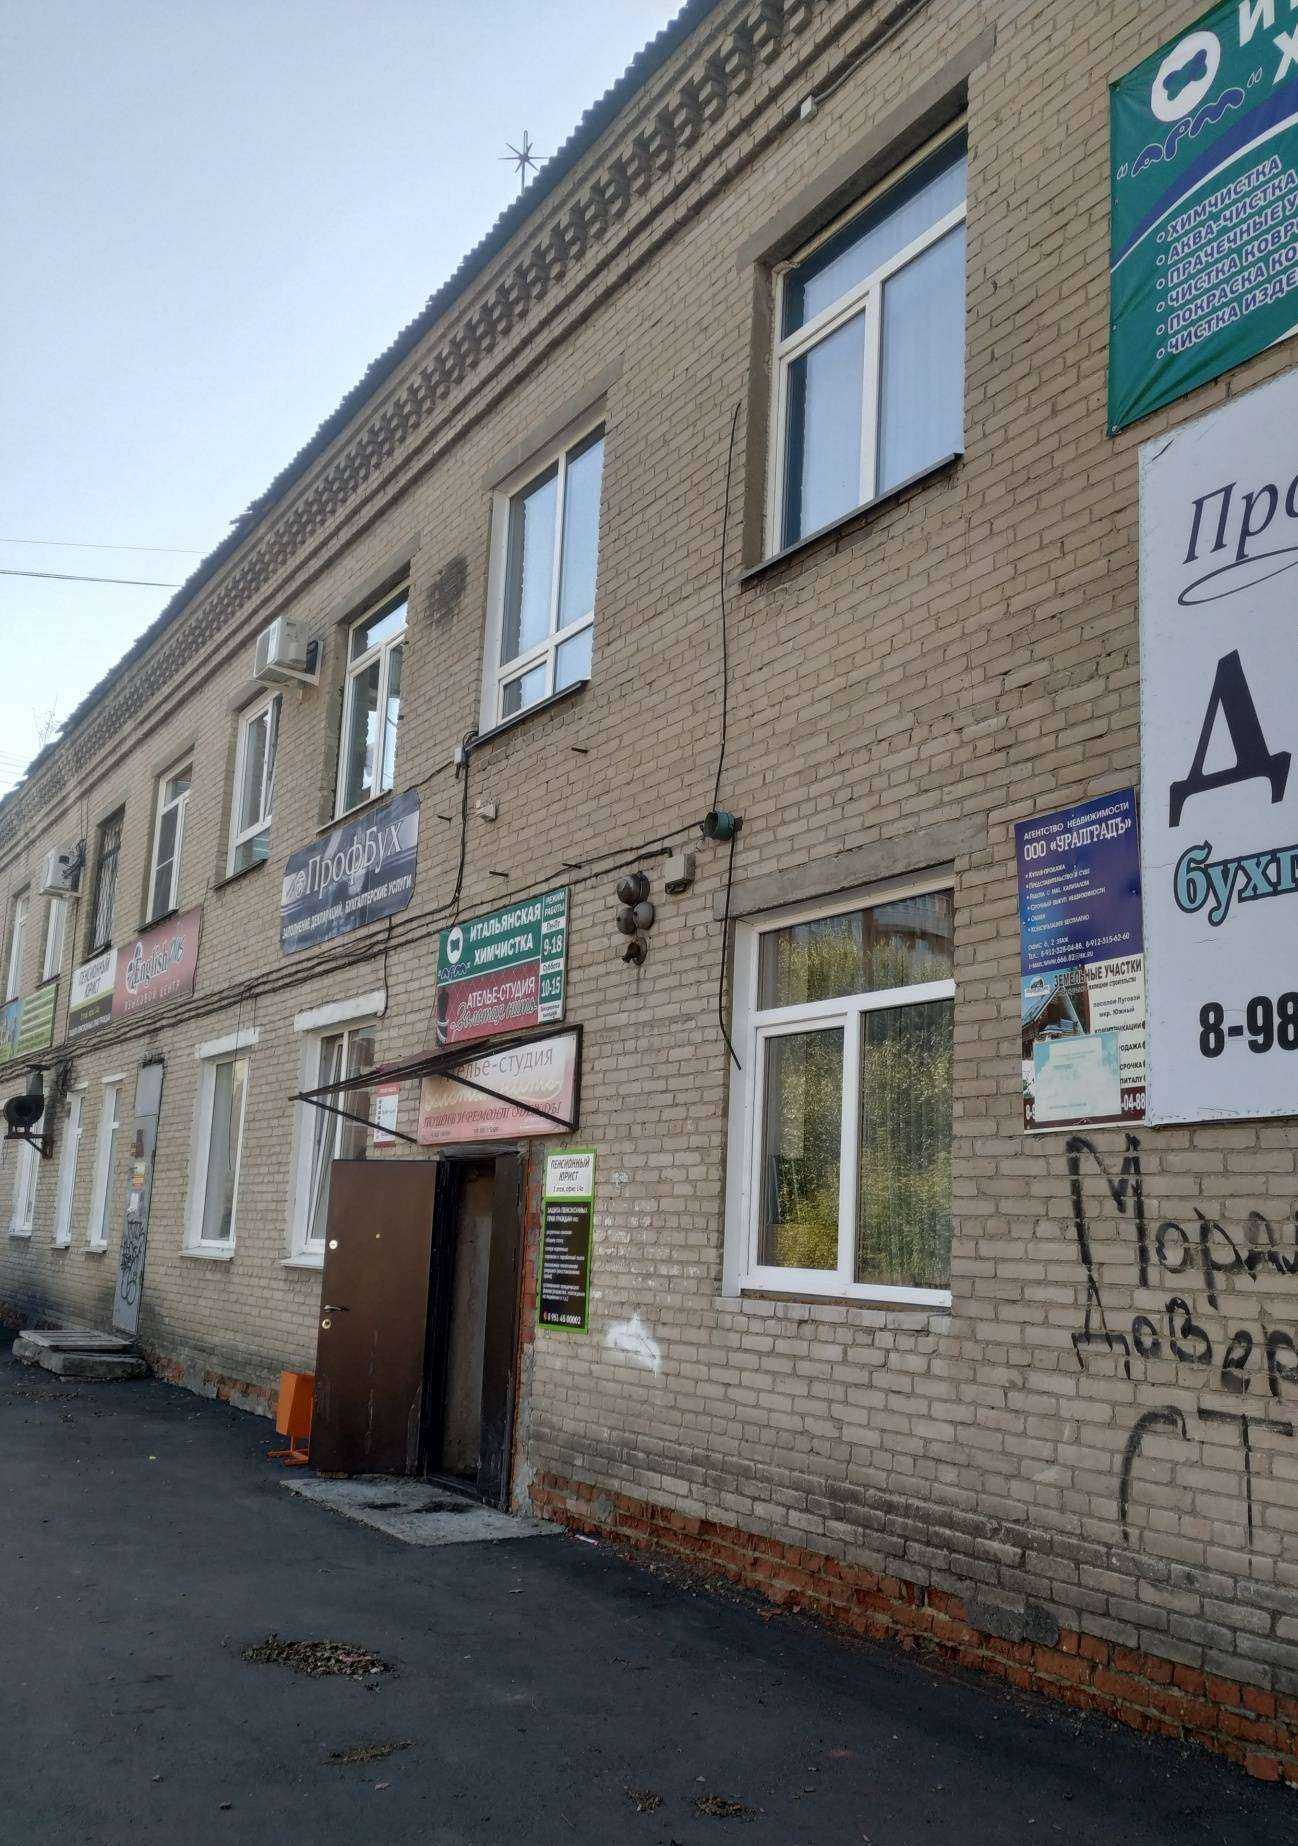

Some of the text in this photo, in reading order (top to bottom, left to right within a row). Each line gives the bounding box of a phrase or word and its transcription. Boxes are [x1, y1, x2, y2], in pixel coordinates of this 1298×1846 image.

[1238, 0, 1298, 48] И
[1167, 154, 1282, 242] ХИМЧИСТКА
[1167, 169, 1298, 264] АКВА-ЧИСТКА
[1167, 200, 1283, 287] ПРАЧЕЧНЫЕ
[1167, 216, 1298, 308] ЧИСТКА КОВР
[1167, 262, 1268, 335] ПОКРАСКА
[1167, 266, 1298, 355] ЧИСТКА ИЗДЕ
[1168, 648, 1292, 828] Д
[1024, 801, 1130, 841] АГЕНТСТВО НЕДВИЖИМОСТИ
[1024, 840, 1047, 861] ООО
[388, 873, 412, 898] УСЛУГИ
[469, 902, 542, 943] ИТАЛЬЯНСКАЯ
[473, 932, 534, 967] ХИМЧИСТКА
[467, 976, 536, 1009] АТЕЛЬЕ-СТУДИЯ
[541, 976, 561, 997] 10-15
[1054, 958, 1142, 988] ЗЕМЕЛЬНЫЕ УЧАСТКИ
[1199, 991, 1298, 1058] 8-98
[449, 1047, 554, 1081] елье-студия
